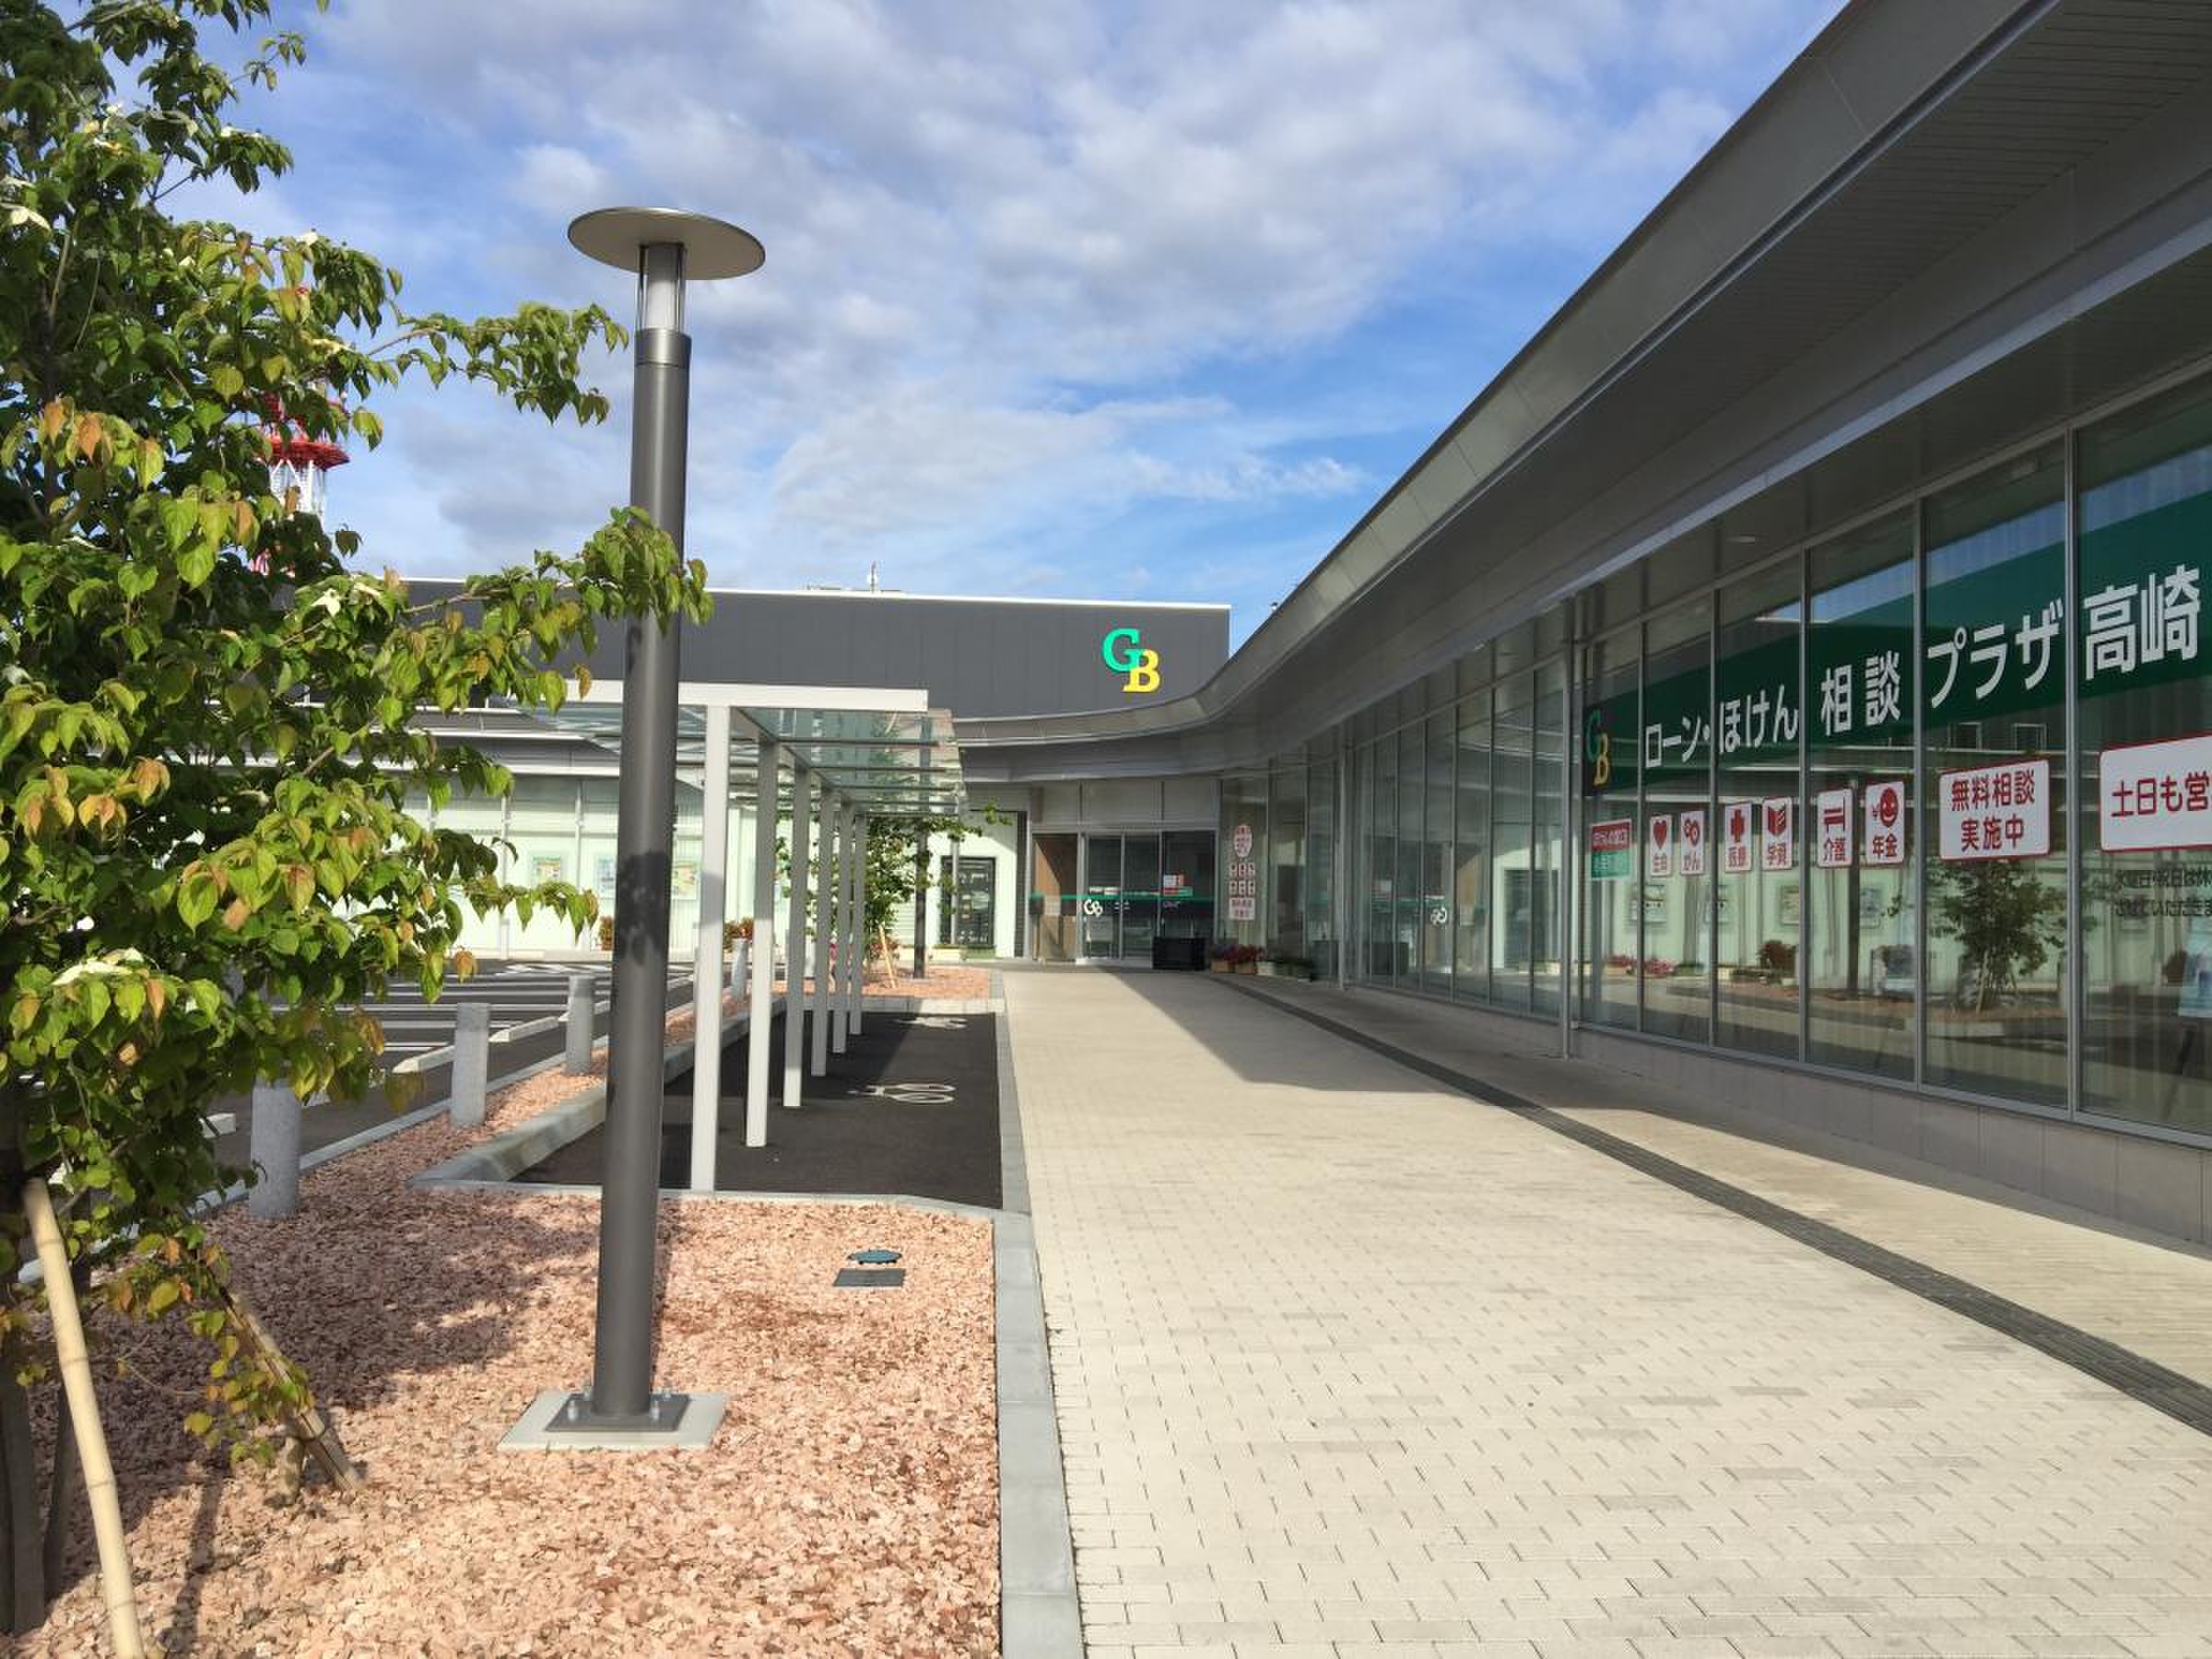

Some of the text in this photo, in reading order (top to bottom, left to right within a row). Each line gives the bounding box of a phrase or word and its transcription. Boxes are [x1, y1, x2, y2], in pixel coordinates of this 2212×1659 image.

[1103, 628, 1160, 692] GB
[1821, 650, 1900, 735] 相談
[1927, 598, 2064, 708] プラザ
[2083, 564, 2200, 680] 高崎
[1951, 770, 2035, 811] 無料相談
[2111, 771, 2210, 818] 土日も営
[1872, 833, 1898, 858] 年金
[1961, 813, 2025, 852] 実施中
